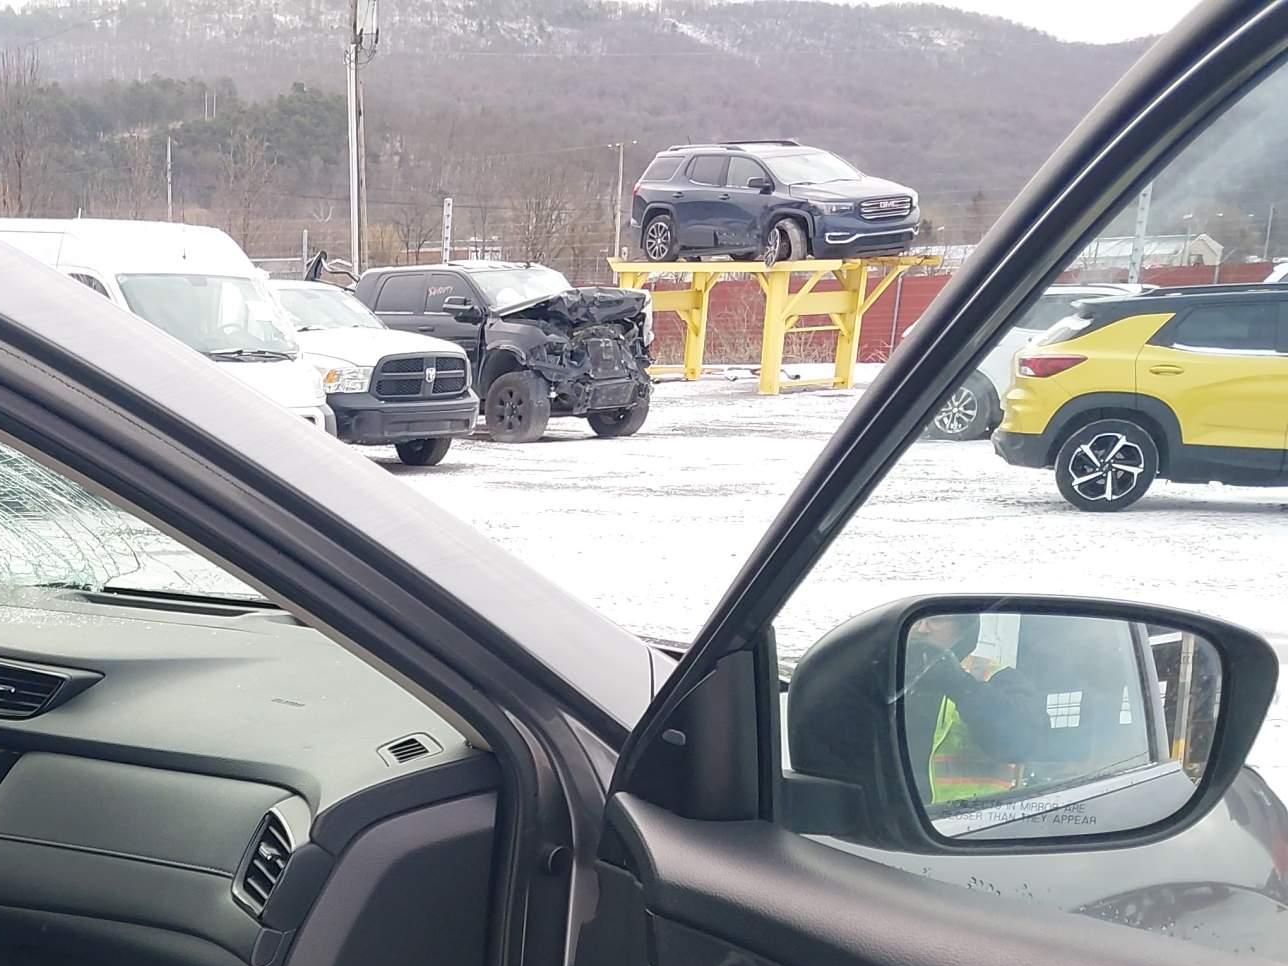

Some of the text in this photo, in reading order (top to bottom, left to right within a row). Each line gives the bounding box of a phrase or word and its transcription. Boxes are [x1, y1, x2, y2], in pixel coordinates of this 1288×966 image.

[1020, 802, 1059, 812] MIRROR
[1063, 803, 1086, 814] ARE
[988, 811, 1017, 822] THAN
[1052, 814, 1098, 825] APPEAR
